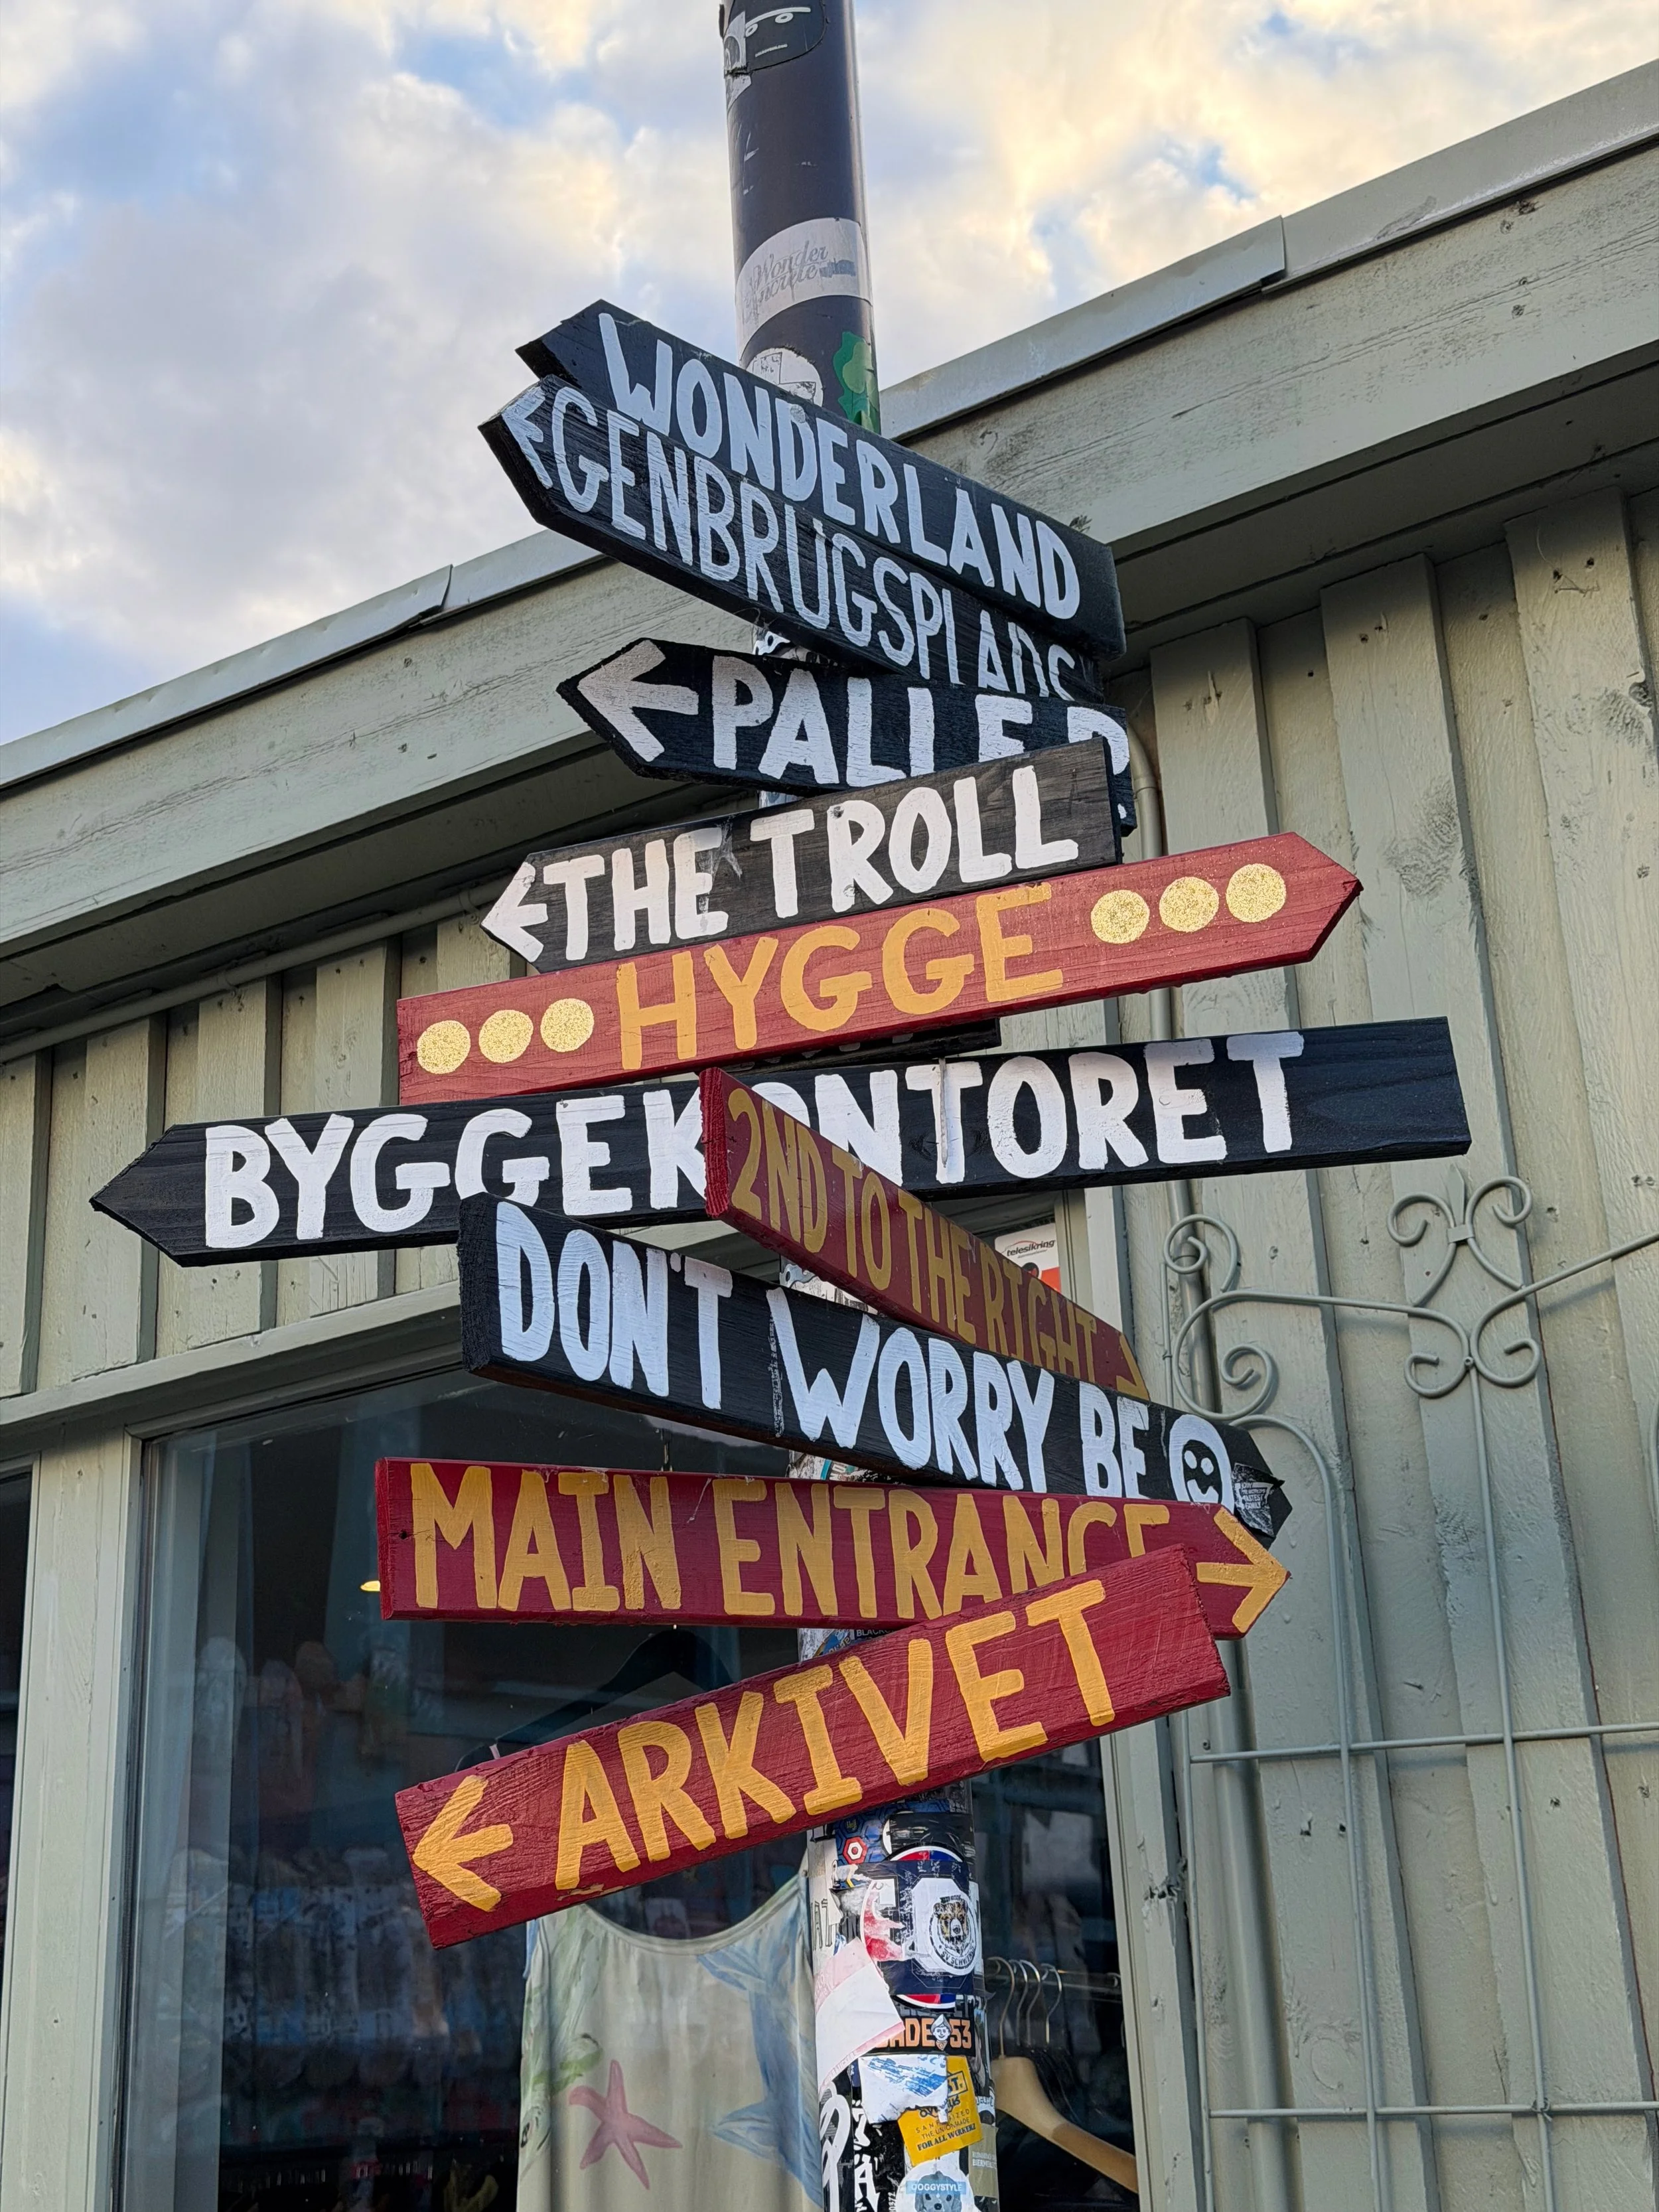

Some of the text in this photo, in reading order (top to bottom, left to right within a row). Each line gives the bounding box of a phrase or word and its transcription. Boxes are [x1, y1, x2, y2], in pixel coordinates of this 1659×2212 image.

[599, 313, 1080, 619] WONDERLAND
[543, 766, 1079, 961] THE TROLL
[616, 882, 1063, 1070] HYGGE
[729, 1087, 1097, 1383] 2ND TO THE RIGHT
[1007, 1240, 1056, 1256] telesikring
[495, 1201, 1151, 1500] DON'T WORRY BE
[411, 1462, 682, 1612] MAIN
[556, 1580, 1116, 1891] ARKIVET
[949, 2018, 972, 2049] 53
[910, 2183, 963, 2192] DOGGYSTYLE
[917, 2140, 934, 2151] FOR
[934, 2134, 948, 2144] ALL
